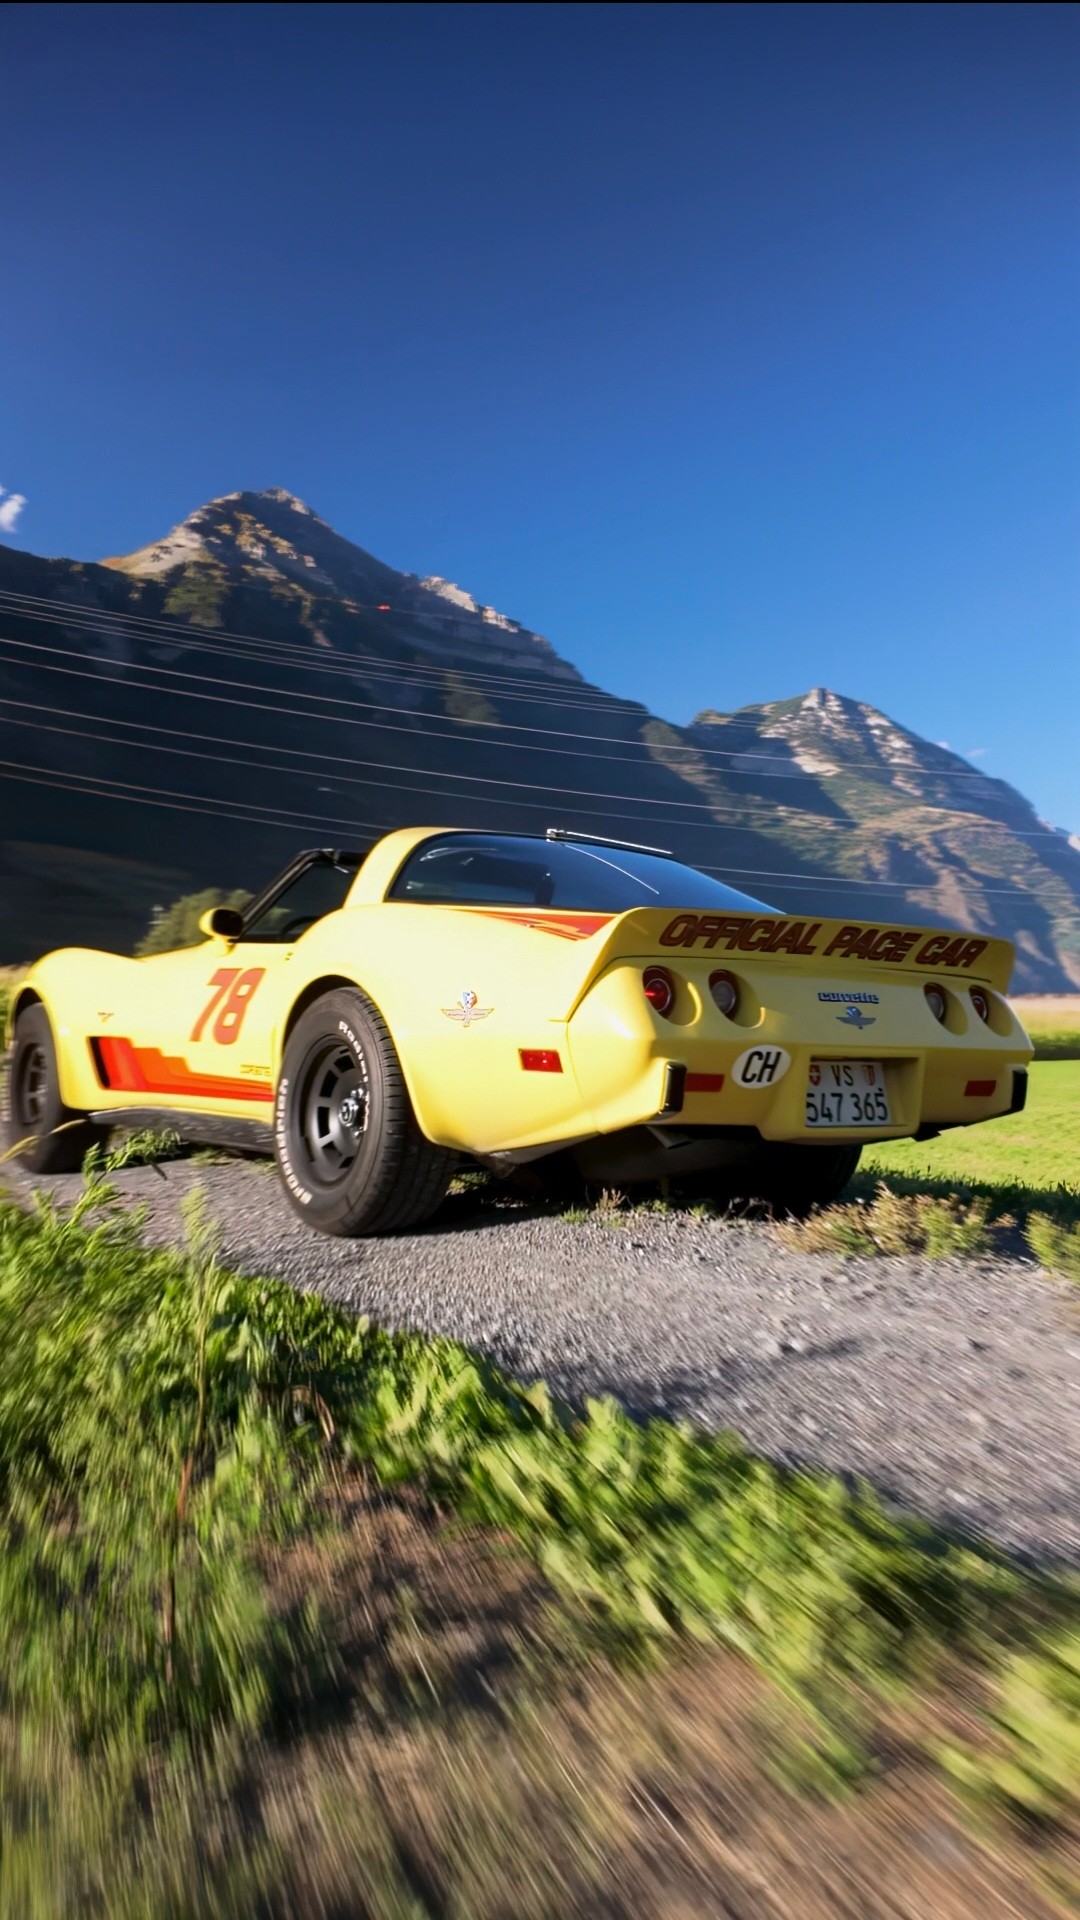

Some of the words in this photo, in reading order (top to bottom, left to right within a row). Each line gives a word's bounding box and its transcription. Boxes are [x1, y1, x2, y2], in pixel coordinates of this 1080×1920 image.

[659, 914, 822, 955] OFFICIAL
[822, 926, 923, 962] PACE
[914, 936, 989, 968] CAR
[189, 968, 267, 1045] 78
[741, 1051, 781, 1083] CH
[830, 1064, 854, 1086] VS
[805, 1093, 843, 1122] 547
[849, 1093, 888, 1122] 365
